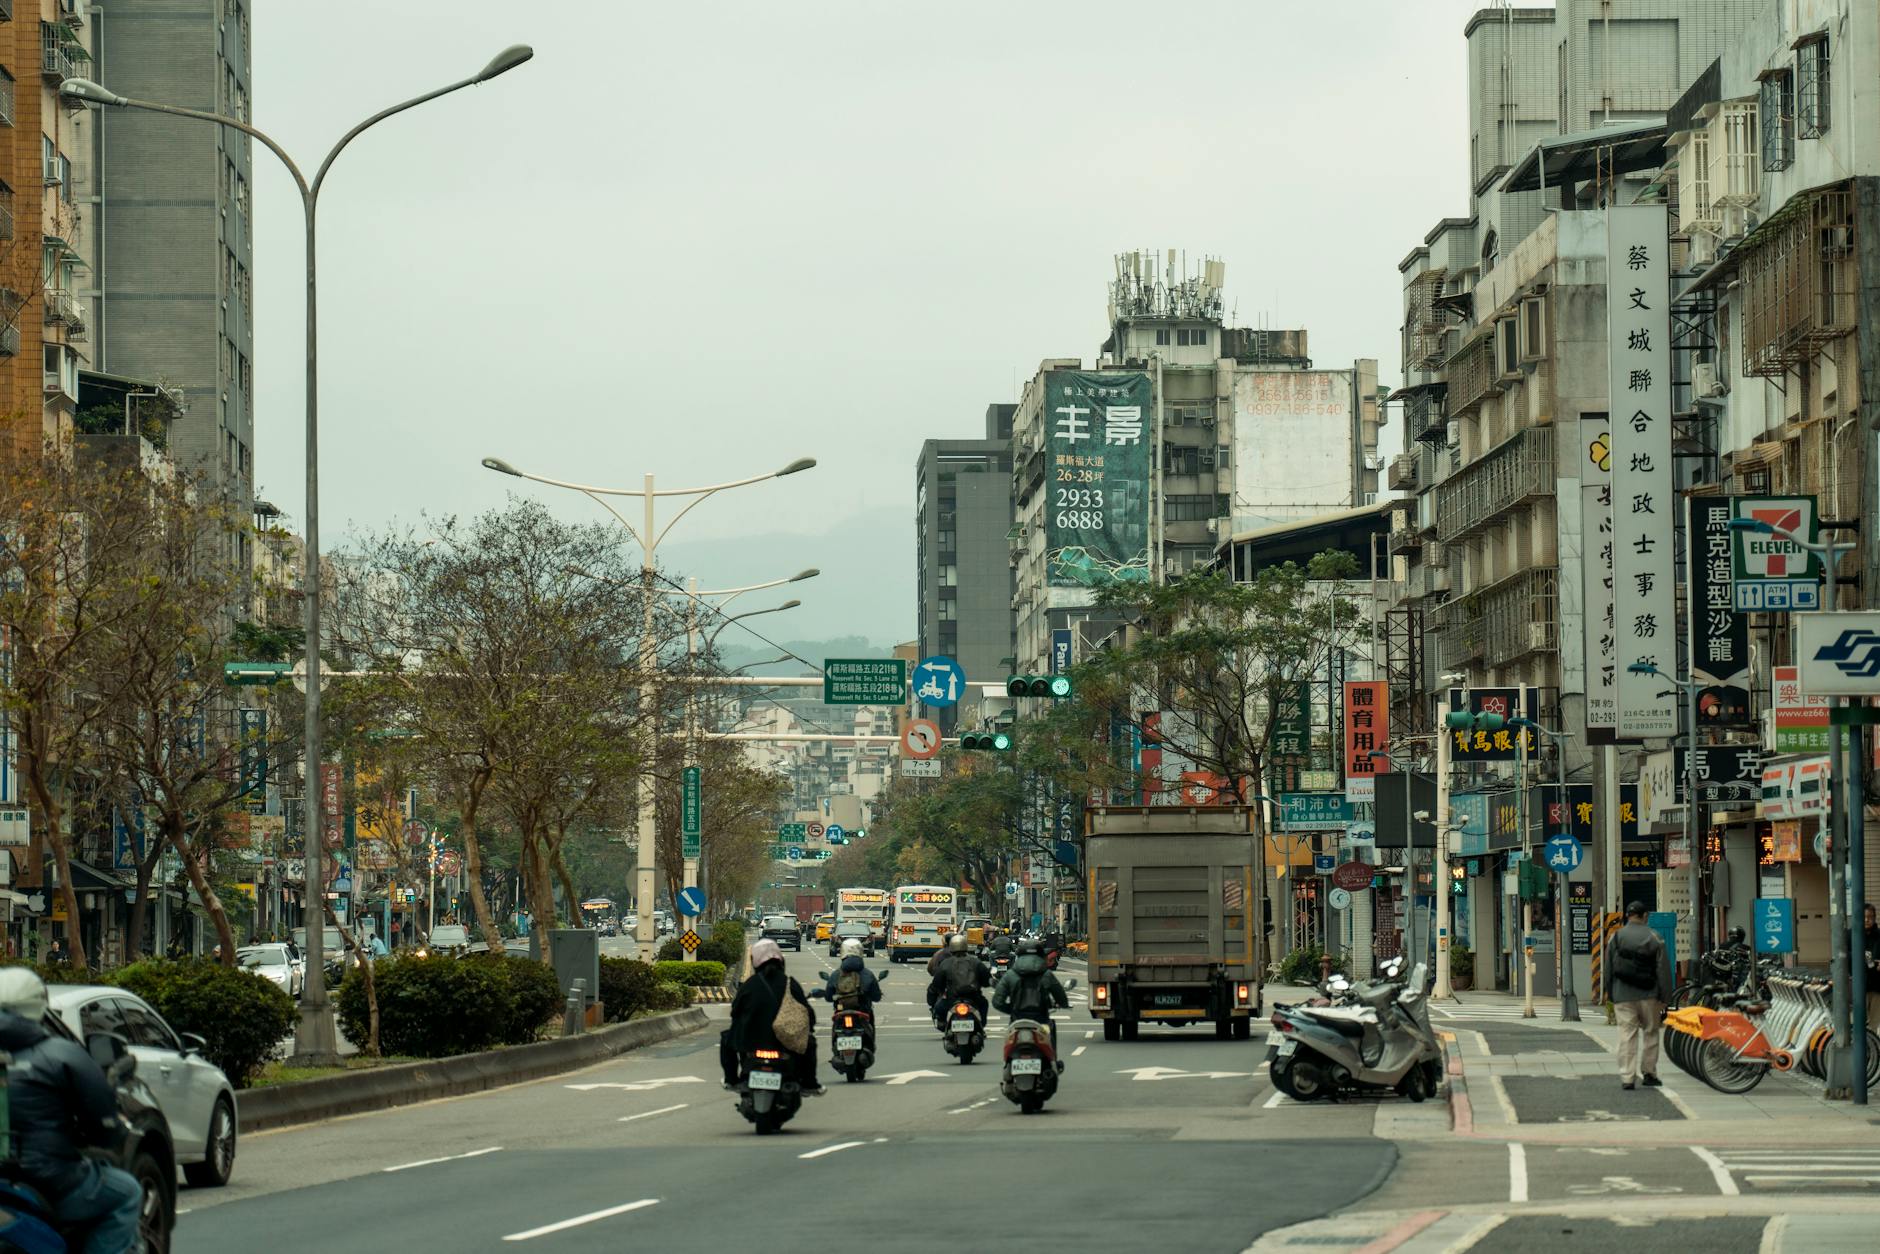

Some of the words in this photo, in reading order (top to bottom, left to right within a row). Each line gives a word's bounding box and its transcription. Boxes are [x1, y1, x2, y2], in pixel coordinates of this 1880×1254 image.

[1056, 454, 1104, 467] 羅斯福大道
[1626, 245, 1658, 678] 蔡文城聯合地政士事務所
[1056, 468, 1104, 483] 26-28坪
[1056, 488, 1104, 508] 2933
[1056, 510, 1104, 530] 6888
[1706, 506, 1733, 662] 馬克造型沙龍
[1768, 586, 1787, 594] ATM
[832, 663, 898, 675] 羅斯福路五段211巷
[832, 682, 898, 694] 羅斯福路五段218巷
[1779, 683, 1800, 705] 樂
[1590, 699, 1614, 708] 預約
[1351, 687, 1375, 773] 體育用品
[912, 760, 931, 768] 7-9
[1680, 749, 1763, 780] 馬克
[1291, 797, 1325, 812] 和沛
